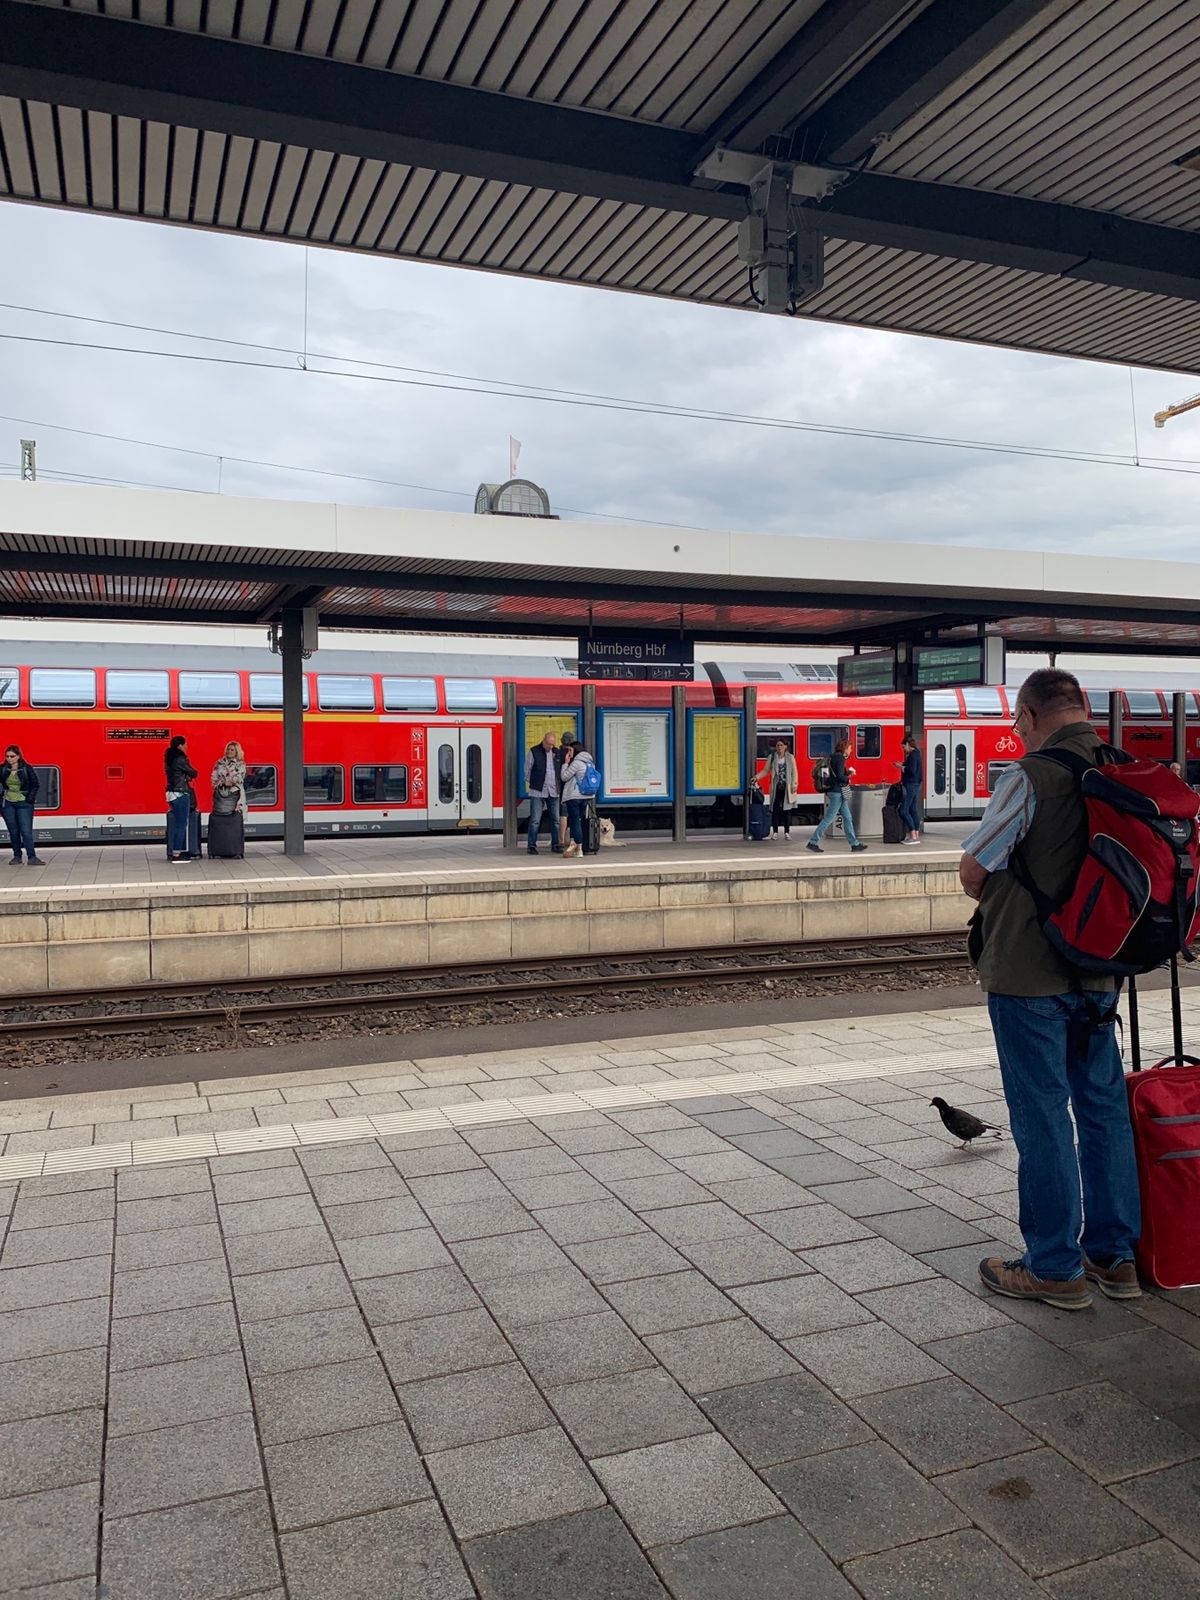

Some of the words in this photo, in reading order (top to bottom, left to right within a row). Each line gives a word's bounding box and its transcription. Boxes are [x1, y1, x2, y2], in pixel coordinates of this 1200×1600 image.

[587, 641, 642, 658] Nürnberg
[645, 643, 667, 656] Hbf
[413, 746, 420, 760] 1
[413, 768, 422, 780] 2
[977, 763, 984, 775] 2
